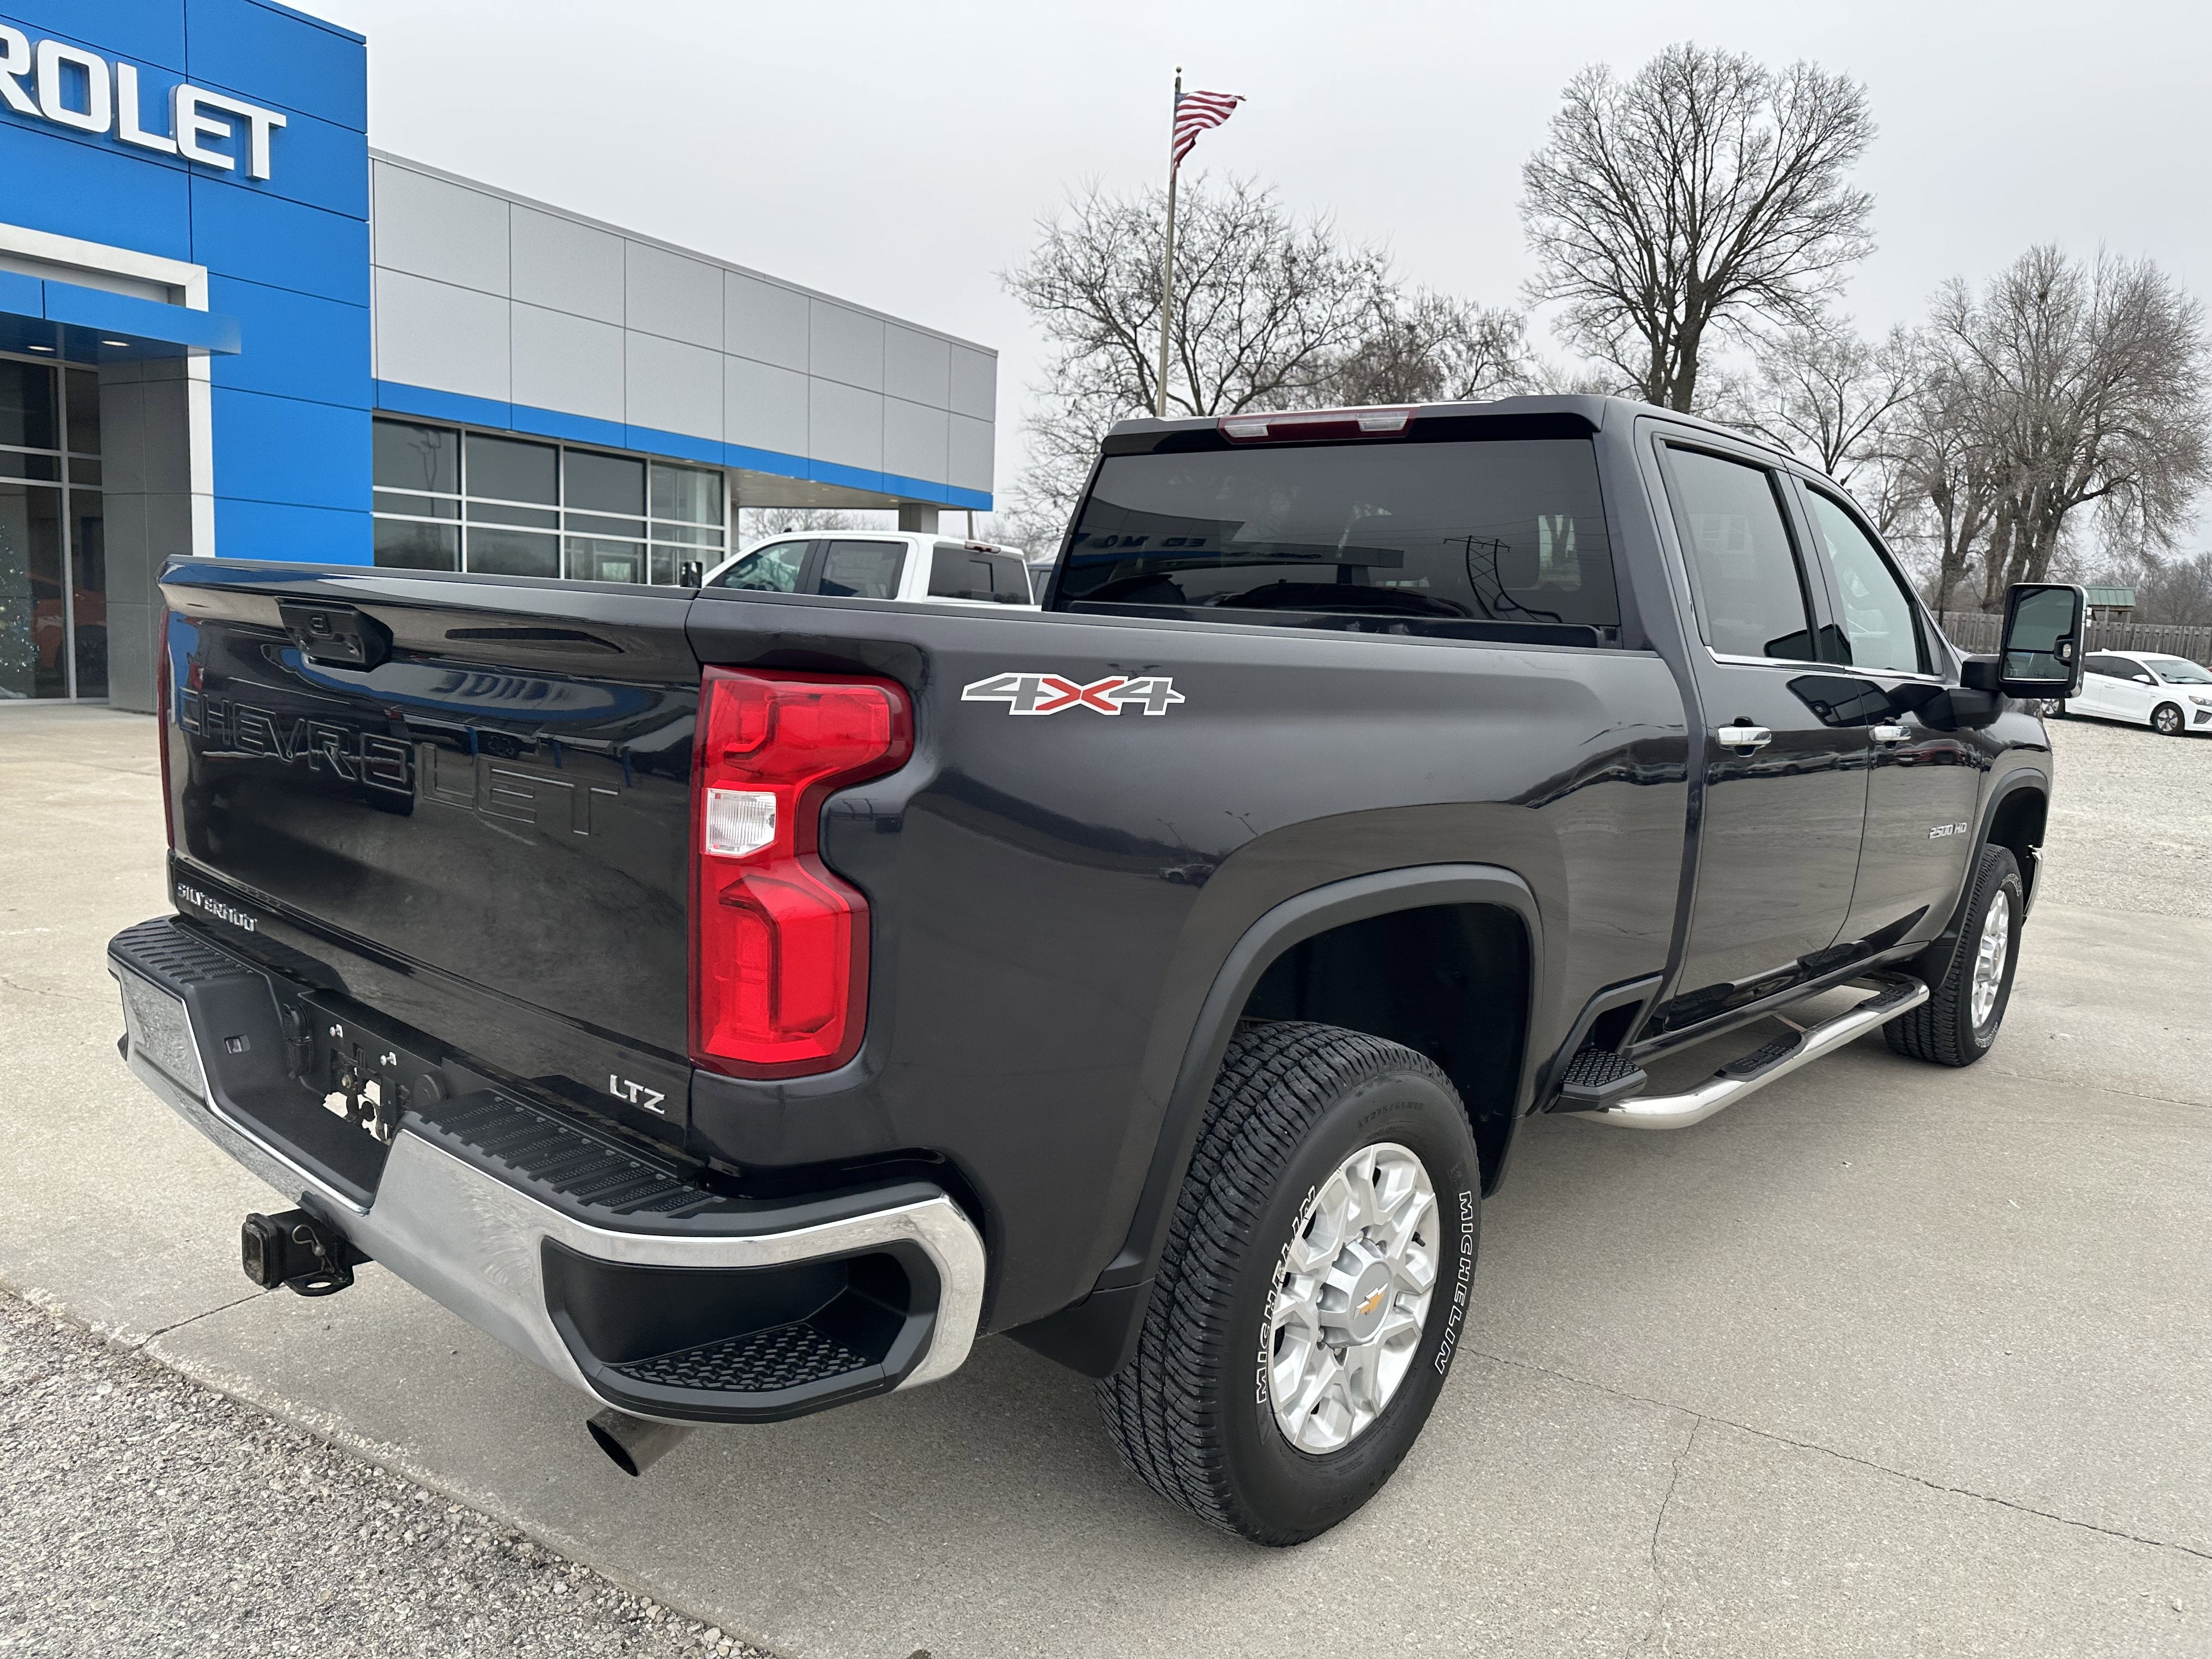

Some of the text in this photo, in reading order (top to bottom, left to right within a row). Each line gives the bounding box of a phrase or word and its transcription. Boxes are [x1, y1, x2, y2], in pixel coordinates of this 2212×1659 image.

[176, 686, 620, 835] CHEVROLET
[1928, 822, 1967, 839] 2500 HD
[610, 1074, 665, 1115] LTZ
[1435, 1190, 1474, 1375] MICHELIN
